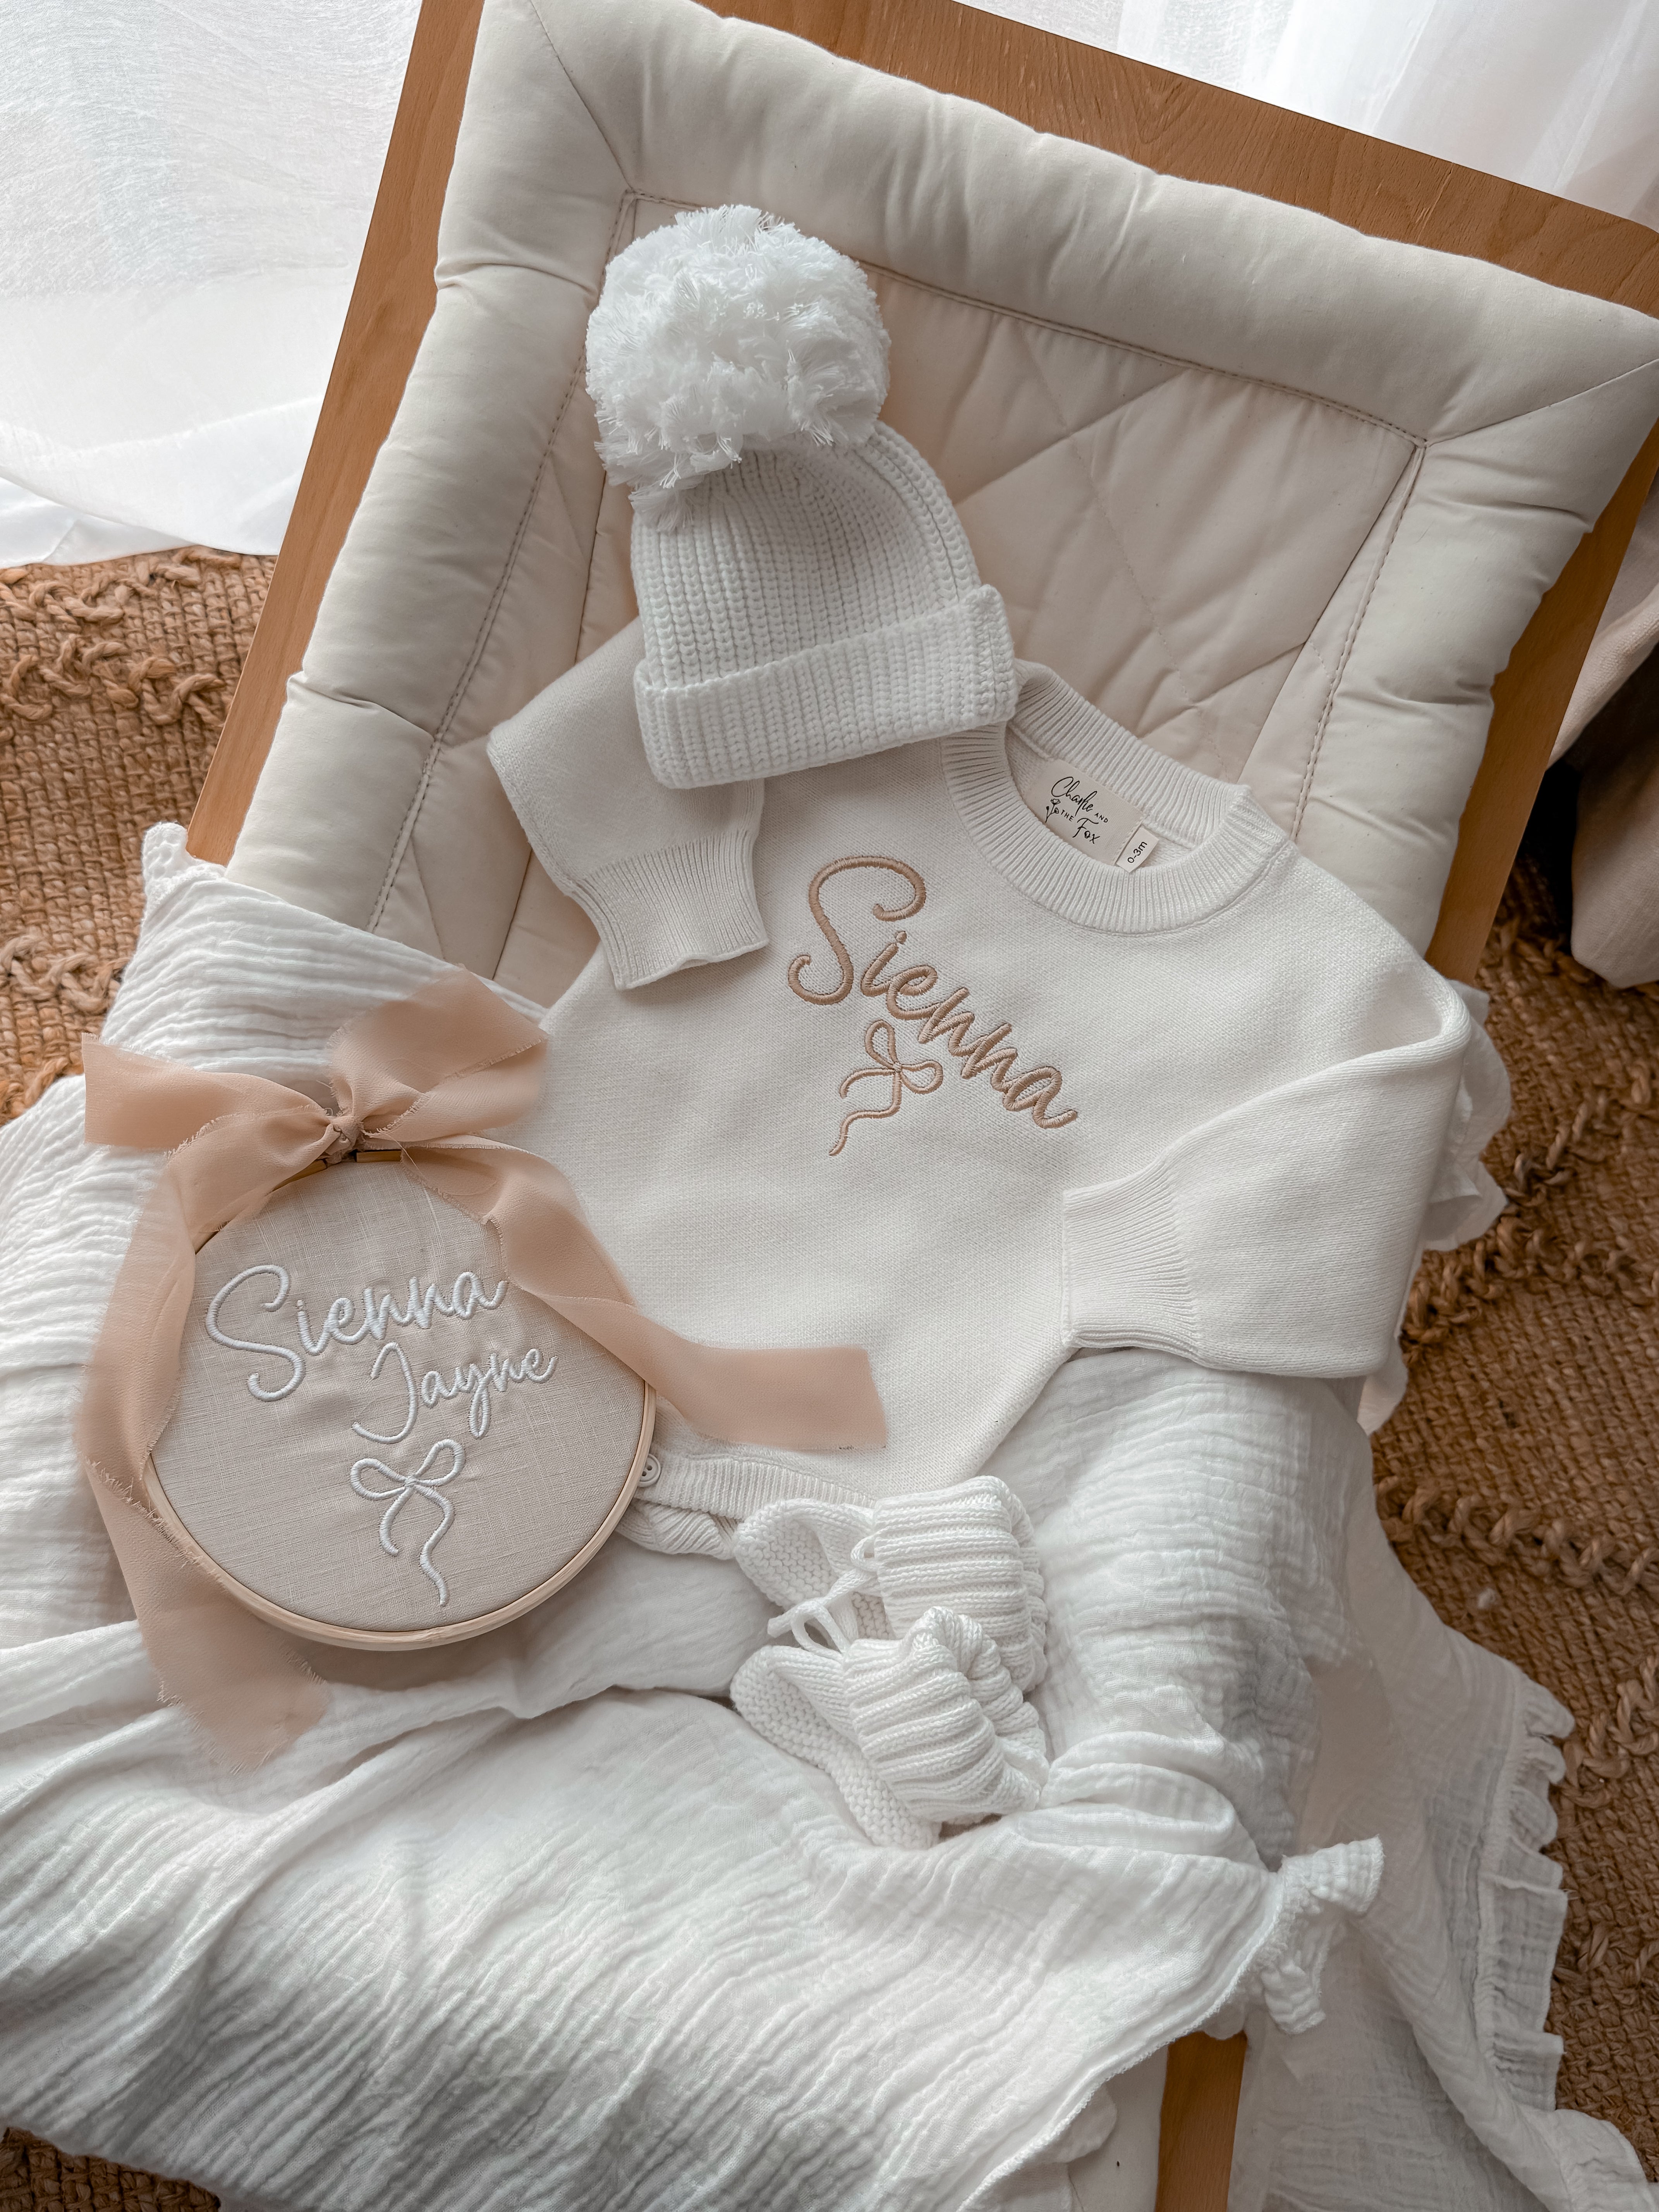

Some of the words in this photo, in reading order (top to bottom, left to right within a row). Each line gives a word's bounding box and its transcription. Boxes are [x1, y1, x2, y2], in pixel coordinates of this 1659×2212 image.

[1061, 809, 1074, 822] THE
[1072, 817, 1101, 844] Fox
[1094, 813, 1108, 823] AND
[1127, 842, 1147, 863] 0-3m
[788, 855, 1078, 1129] Sienna
[205, 1264, 508, 1401] Sienna
[352, 1341, 558, 1444] Jayne
